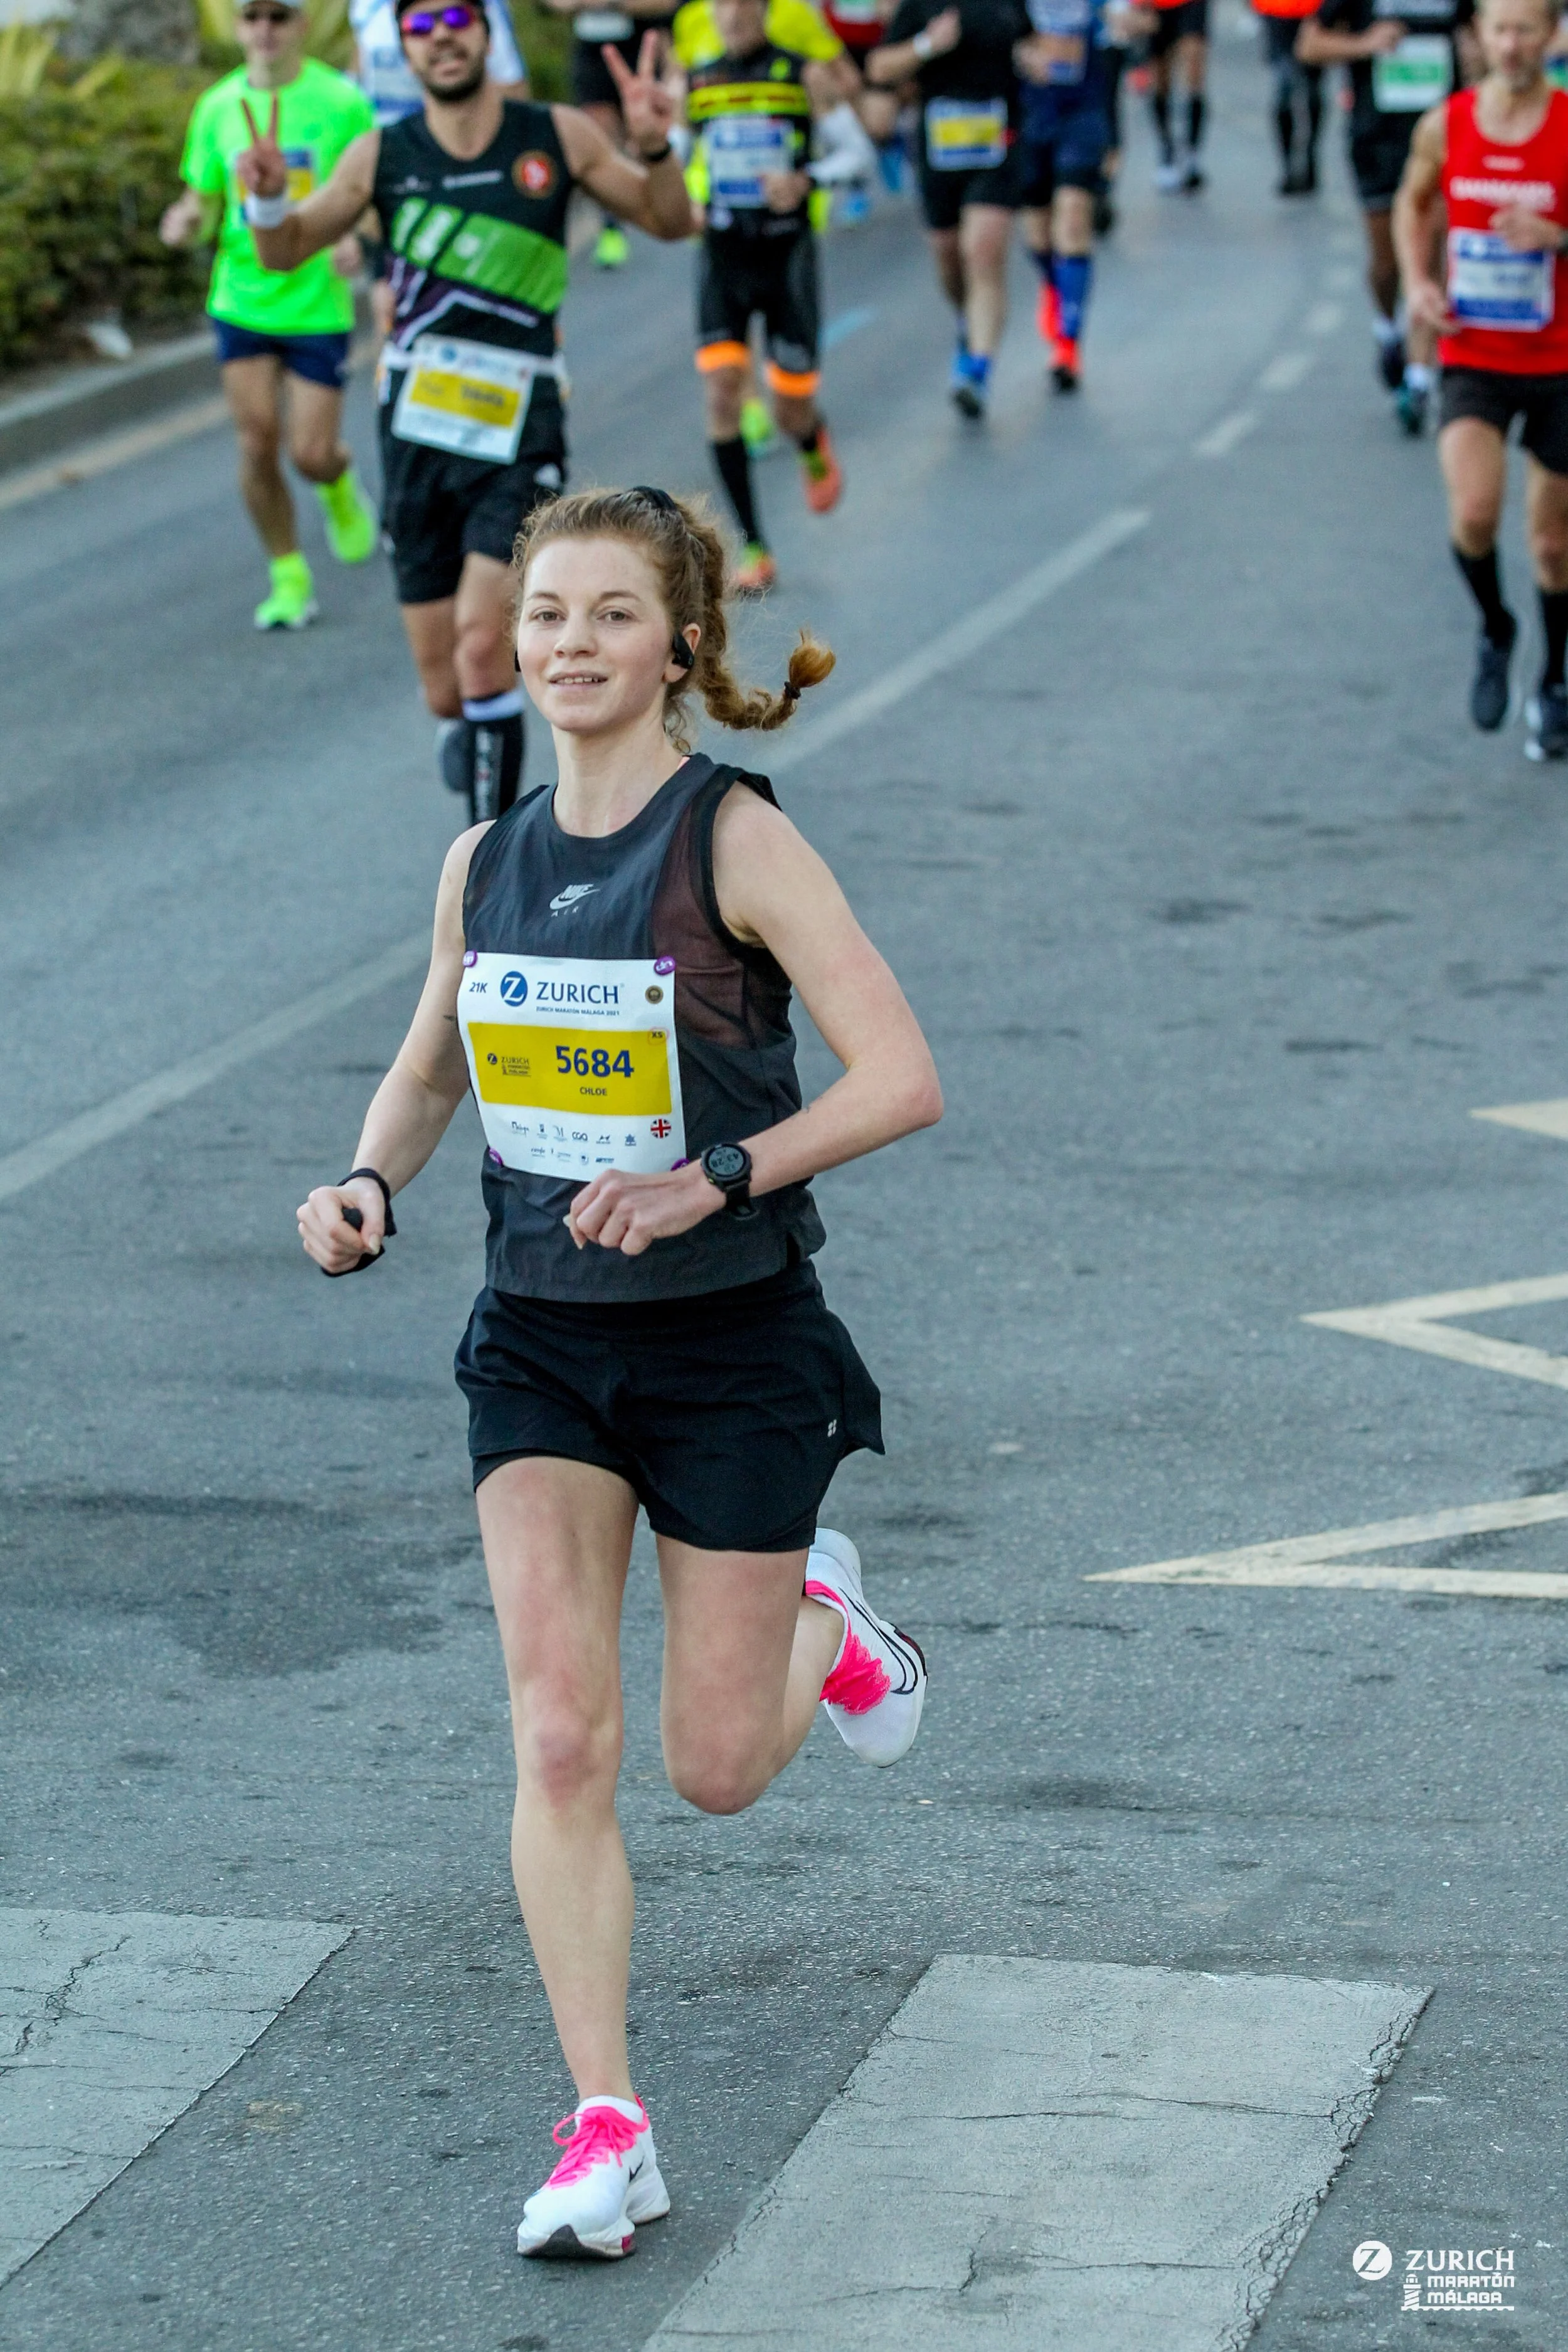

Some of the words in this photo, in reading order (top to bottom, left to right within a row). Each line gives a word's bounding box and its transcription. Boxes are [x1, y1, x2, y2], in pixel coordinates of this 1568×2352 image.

[469, 982, 488, 993] 21K
[536, 982, 619, 1004] ZURICH
[652, 1030, 663, 1039] XS
[556, 1046, 634, 1078] 5684
[580, 1086, 607, 1096] CHLOE
